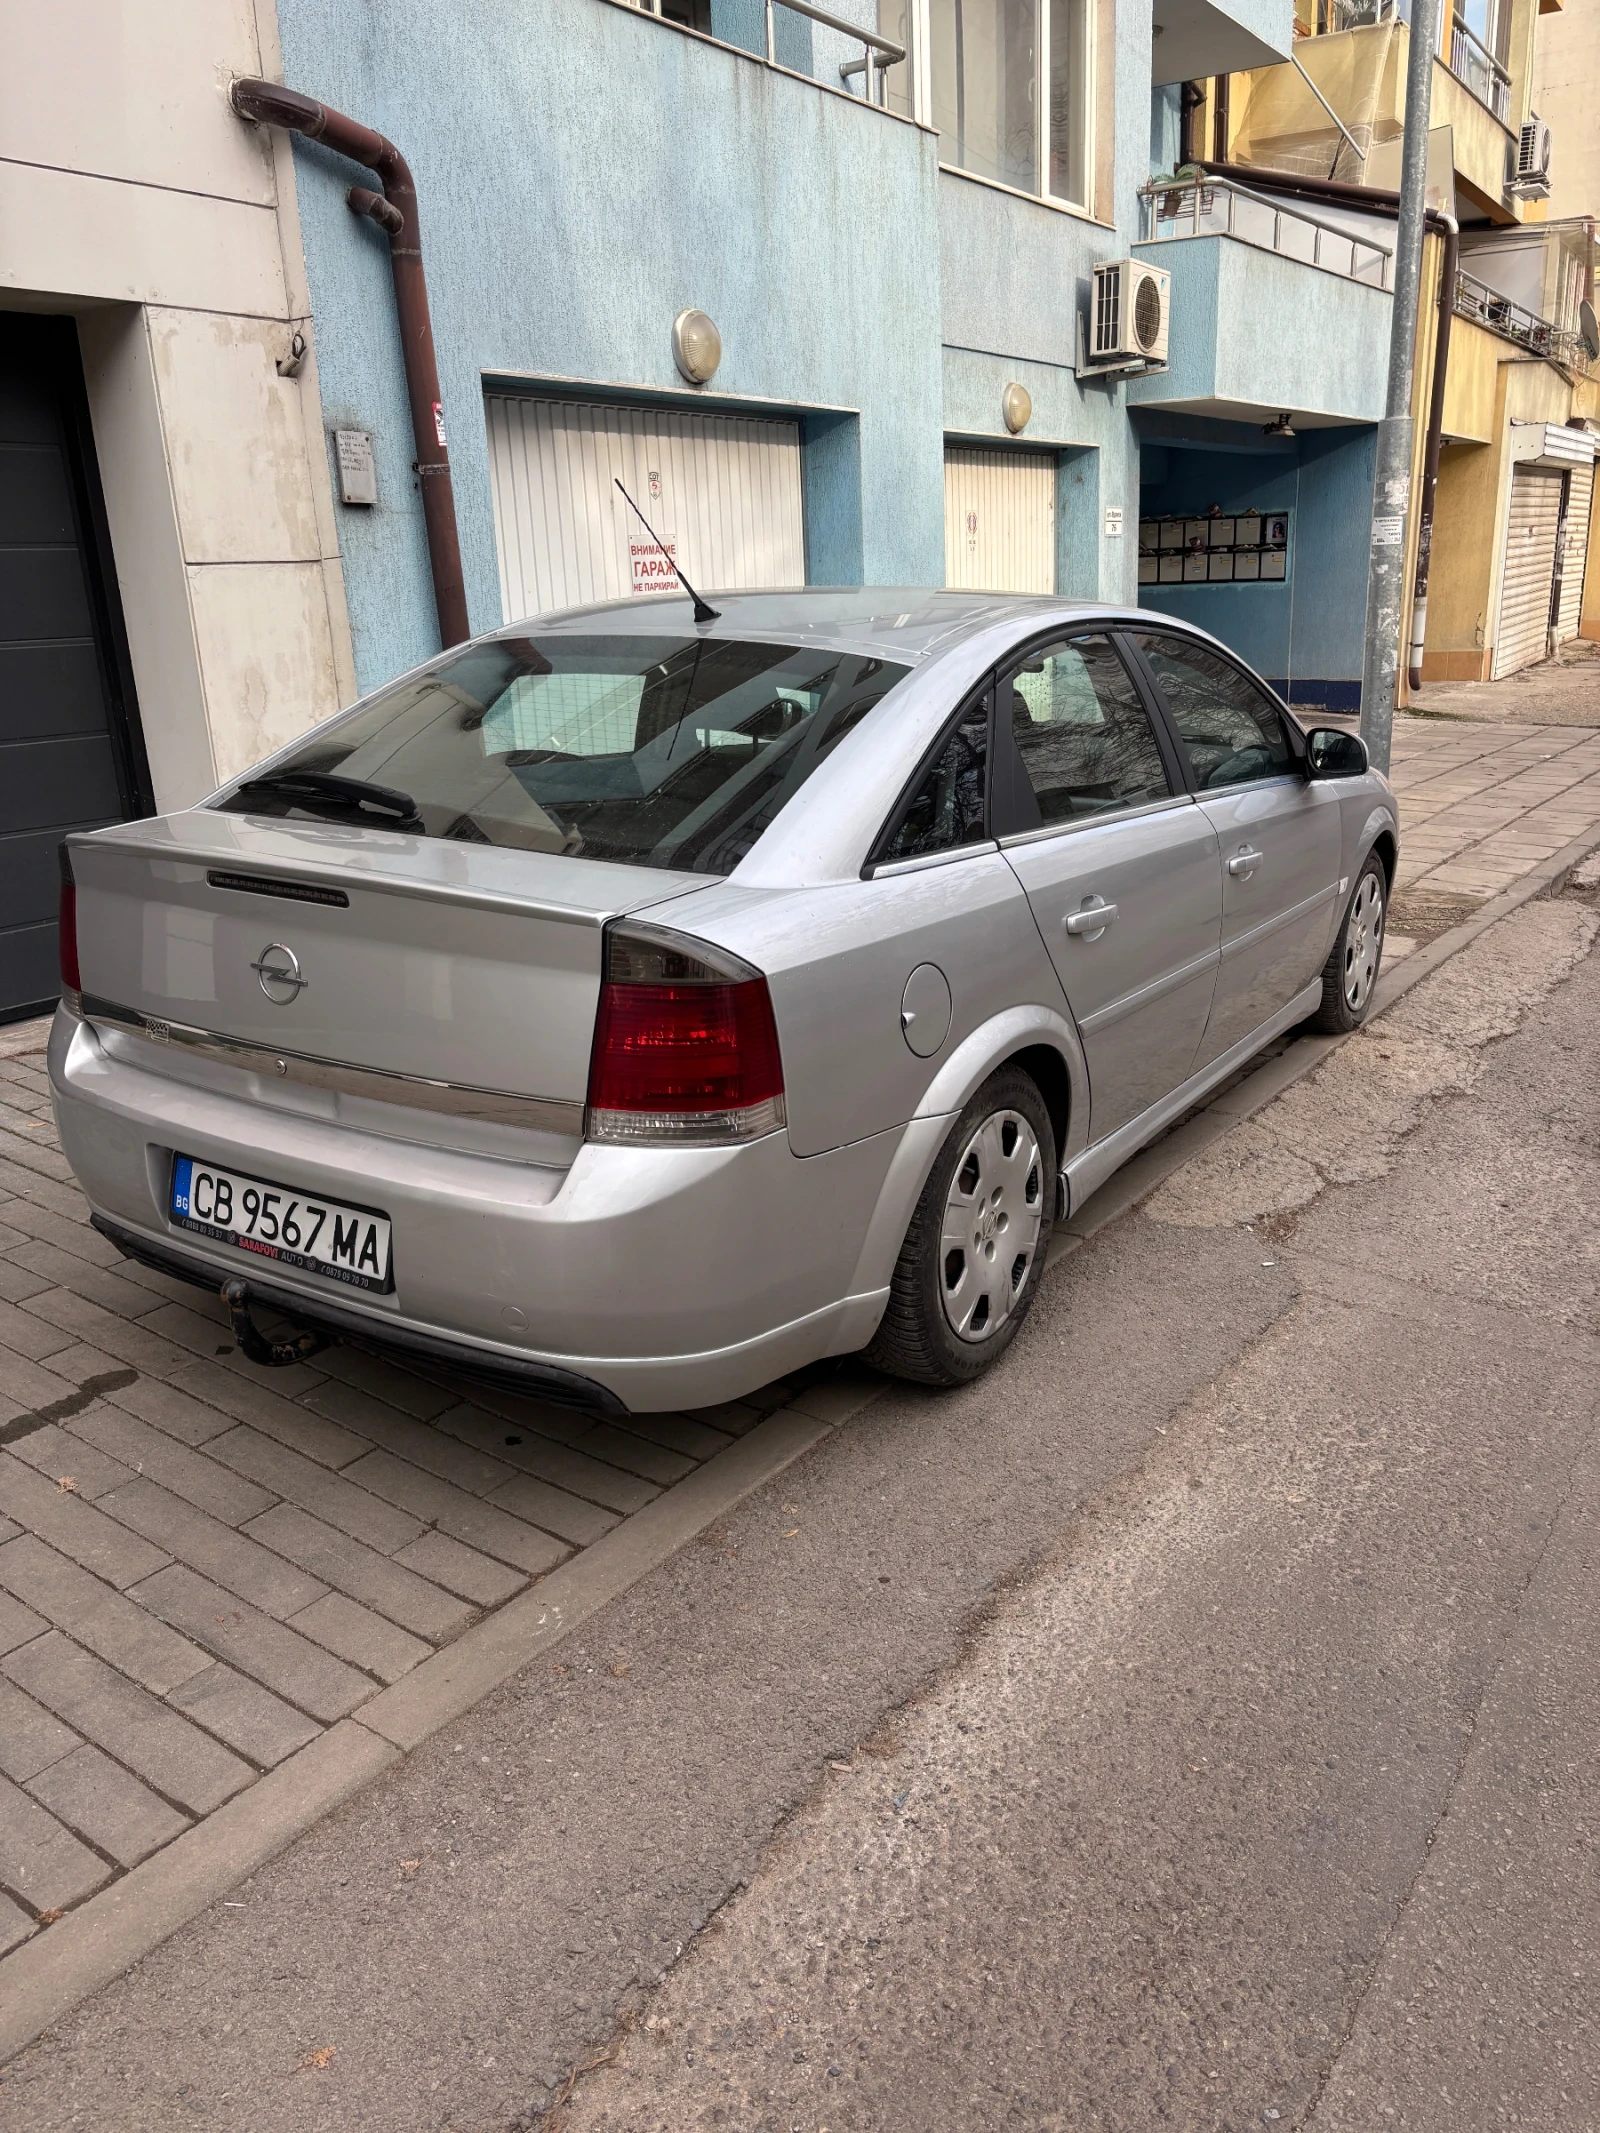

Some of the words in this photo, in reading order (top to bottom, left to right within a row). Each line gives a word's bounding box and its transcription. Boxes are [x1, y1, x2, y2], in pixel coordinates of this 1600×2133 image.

[630, 544, 676, 556] ВНИМАНИЕ
[634, 560, 677, 577] ГАРАЖ
[633, 583, 644, 592] НЕ
[644, 579, 679, 592] ПАРКИРАЙ
[175, 1194, 189, 1211] BG
[194, 1172, 233, 1226] CB
[242, 1188, 327, 1253] 9567
[332, 1214, 380, 1275] MA
